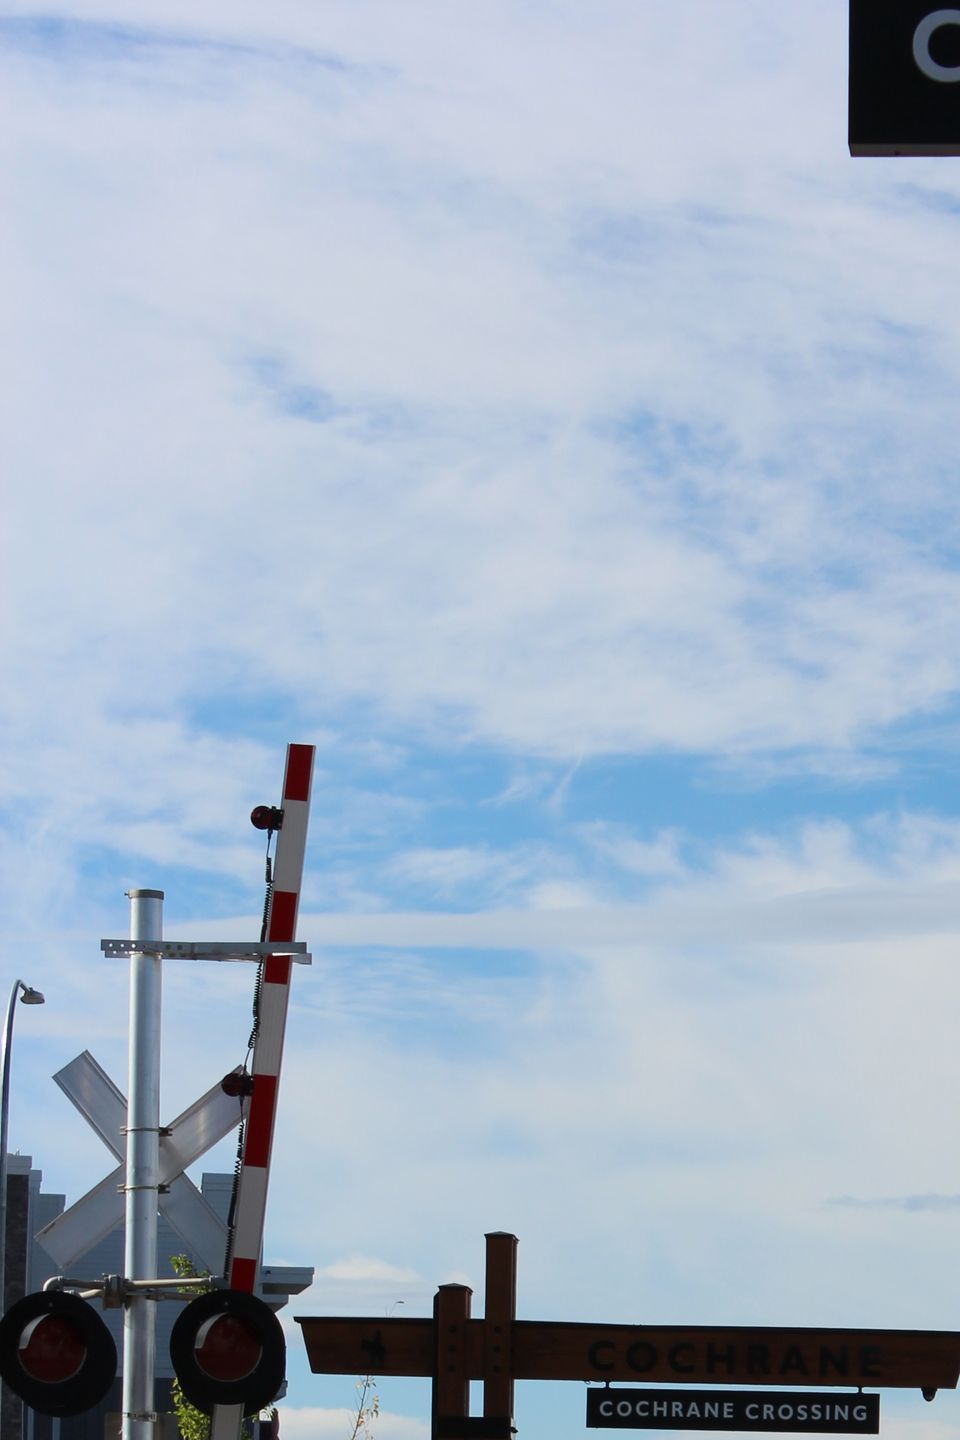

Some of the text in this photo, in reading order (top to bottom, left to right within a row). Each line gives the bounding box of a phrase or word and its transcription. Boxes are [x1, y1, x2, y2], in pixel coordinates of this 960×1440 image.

[587, 1340, 881, 1377] COCHRANE
[599, 1400, 868, 1421] COCHRANE CROSSING
